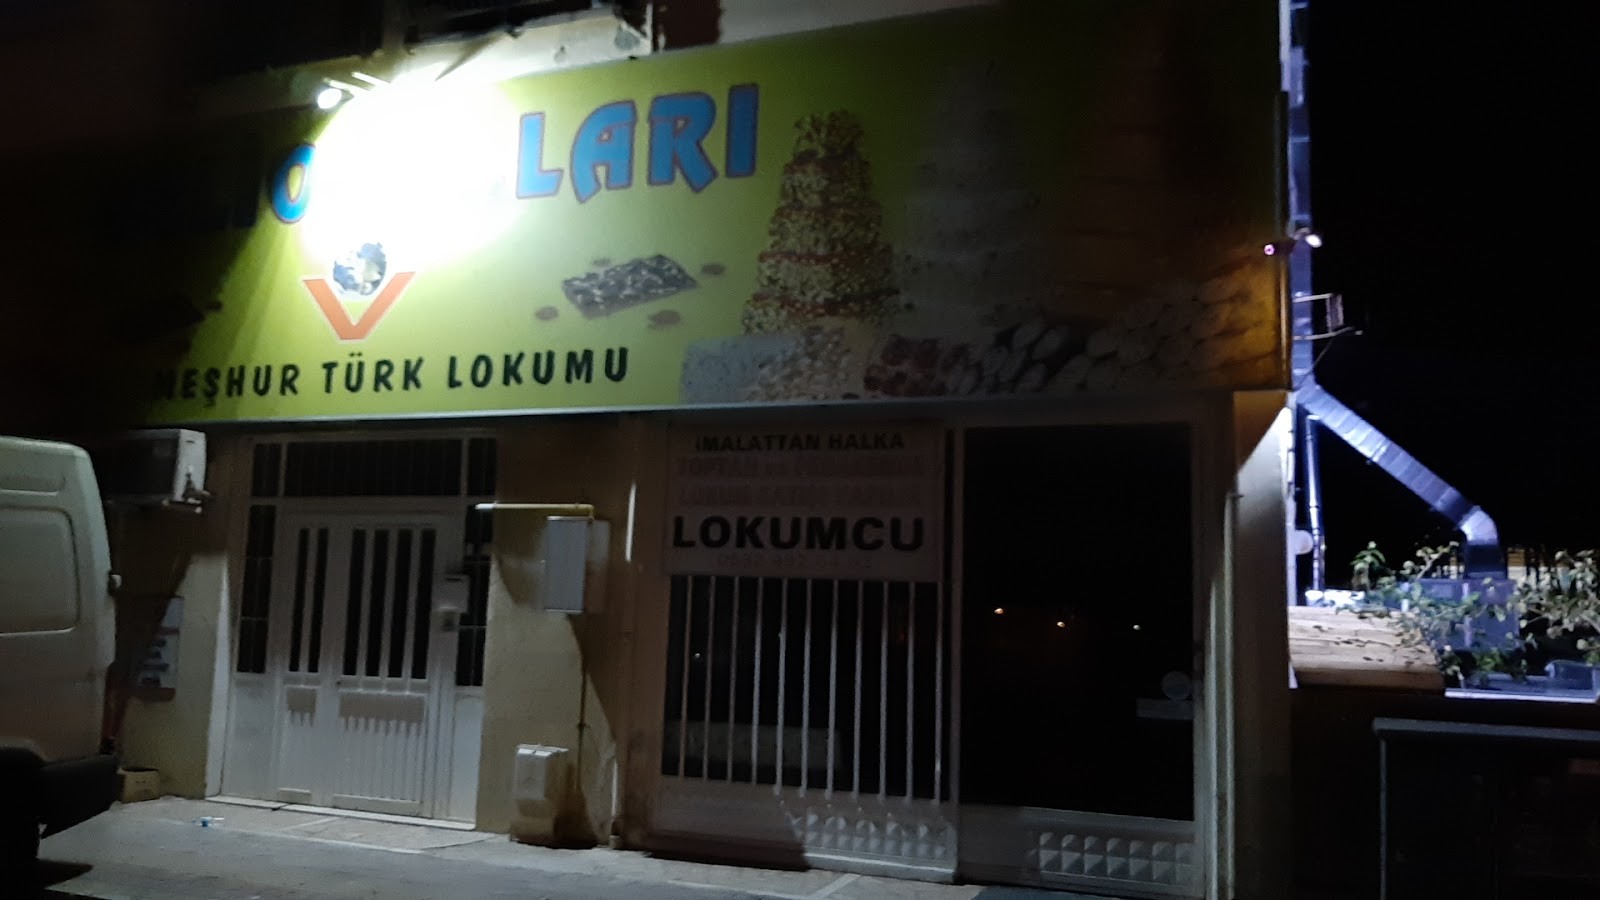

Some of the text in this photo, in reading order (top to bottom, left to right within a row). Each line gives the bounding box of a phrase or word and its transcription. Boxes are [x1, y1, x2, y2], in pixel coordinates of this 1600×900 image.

[154, 347, 628, 408] MEŞHUR TÜRK LOKUMU
[829, 432, 905, 450] HALKA
[673, 515, 925, 551] LOKUMCU
